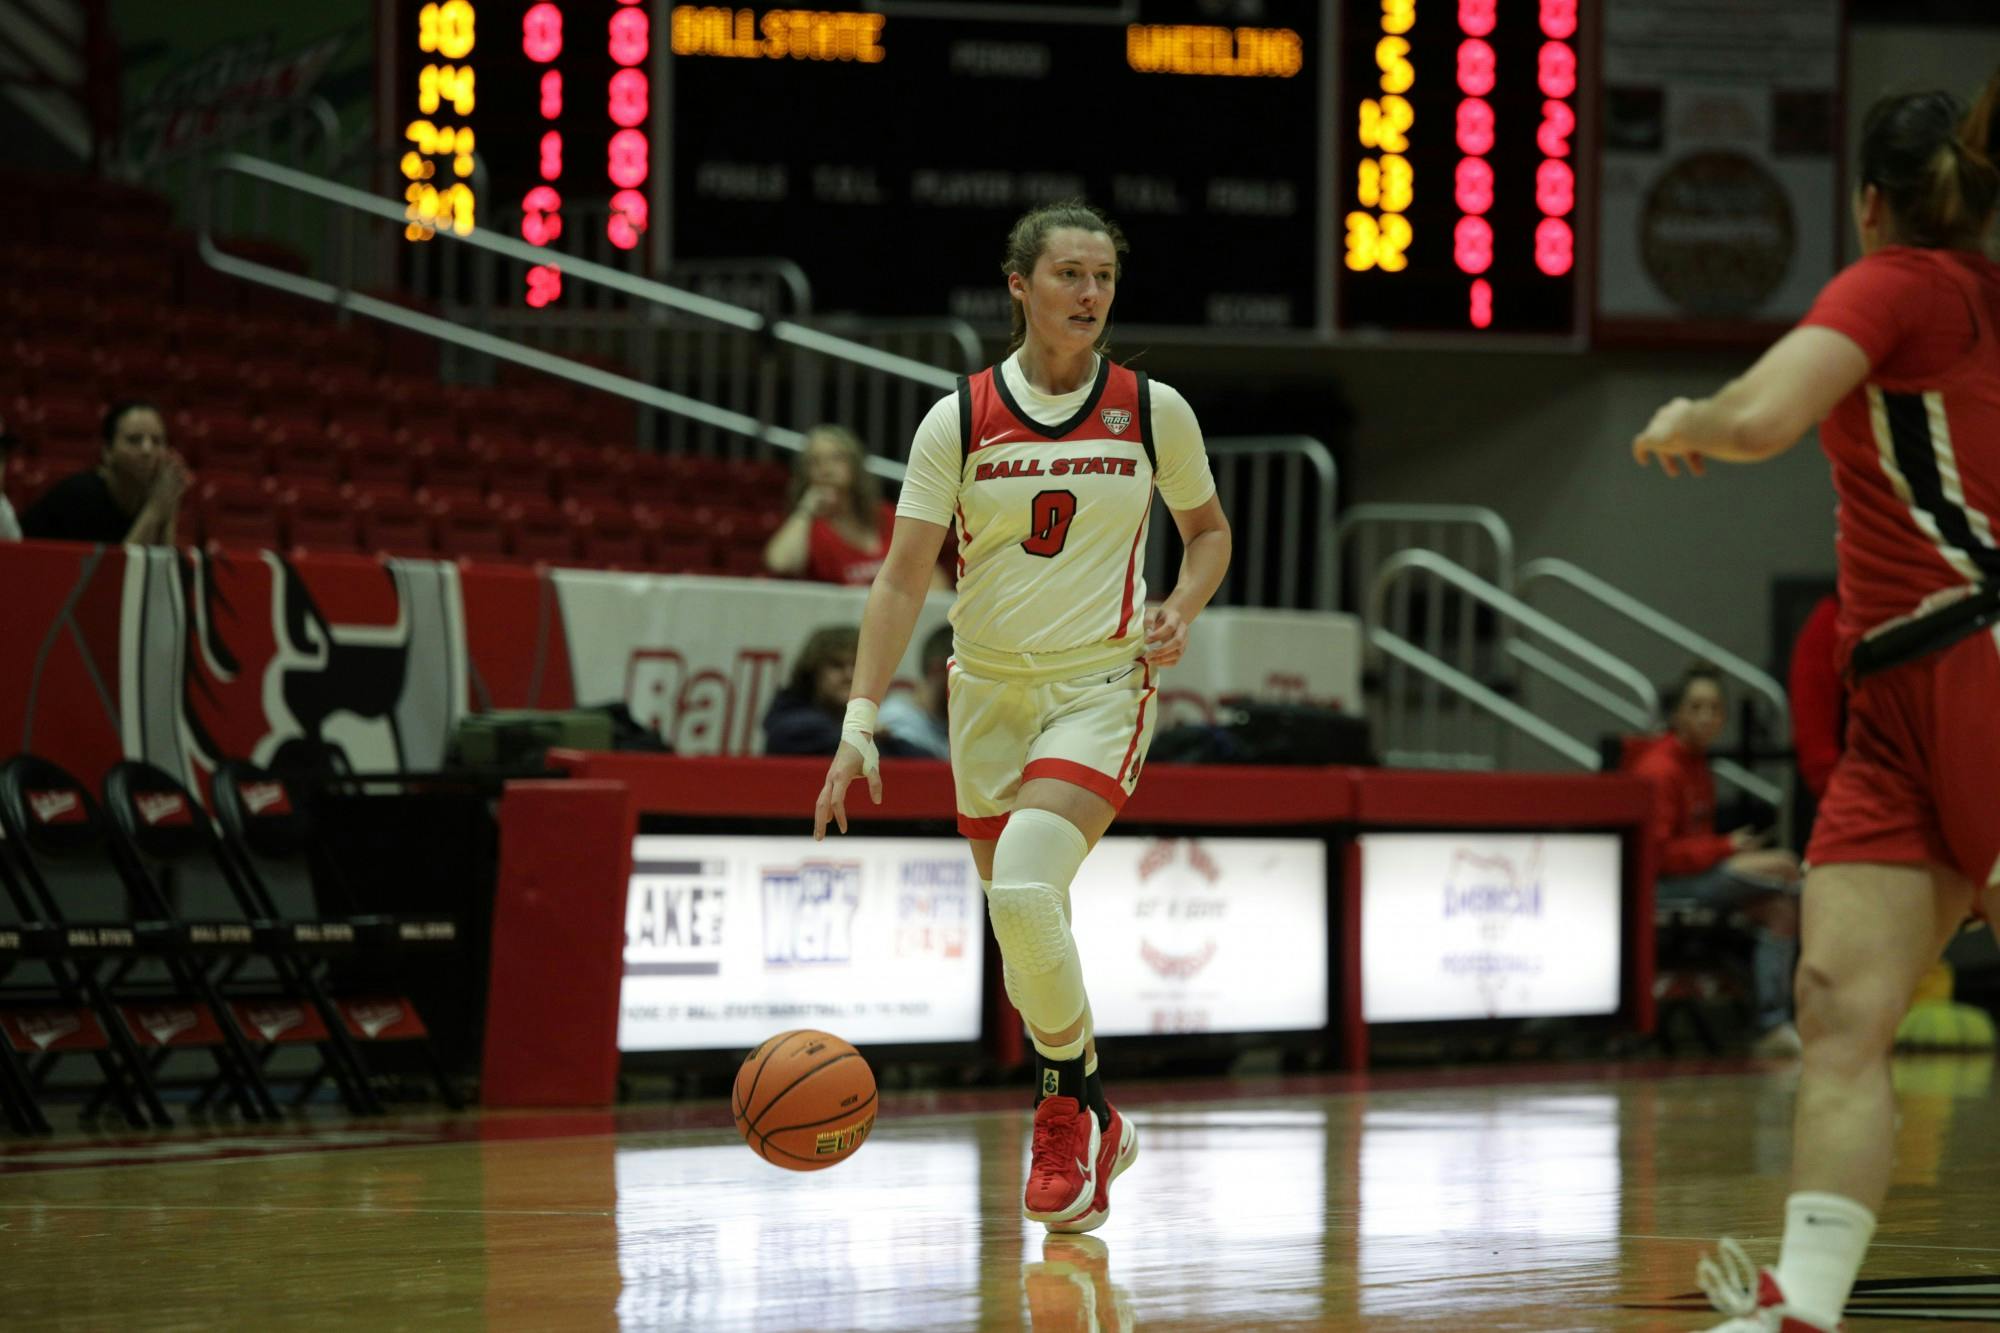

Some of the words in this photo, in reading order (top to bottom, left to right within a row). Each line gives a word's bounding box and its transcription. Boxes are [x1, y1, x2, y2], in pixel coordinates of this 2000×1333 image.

[975, 459, 1044, 481] BALL
[1049, 457, 1137, 477] STATE
[1021, 489, 1077, 558] 0
